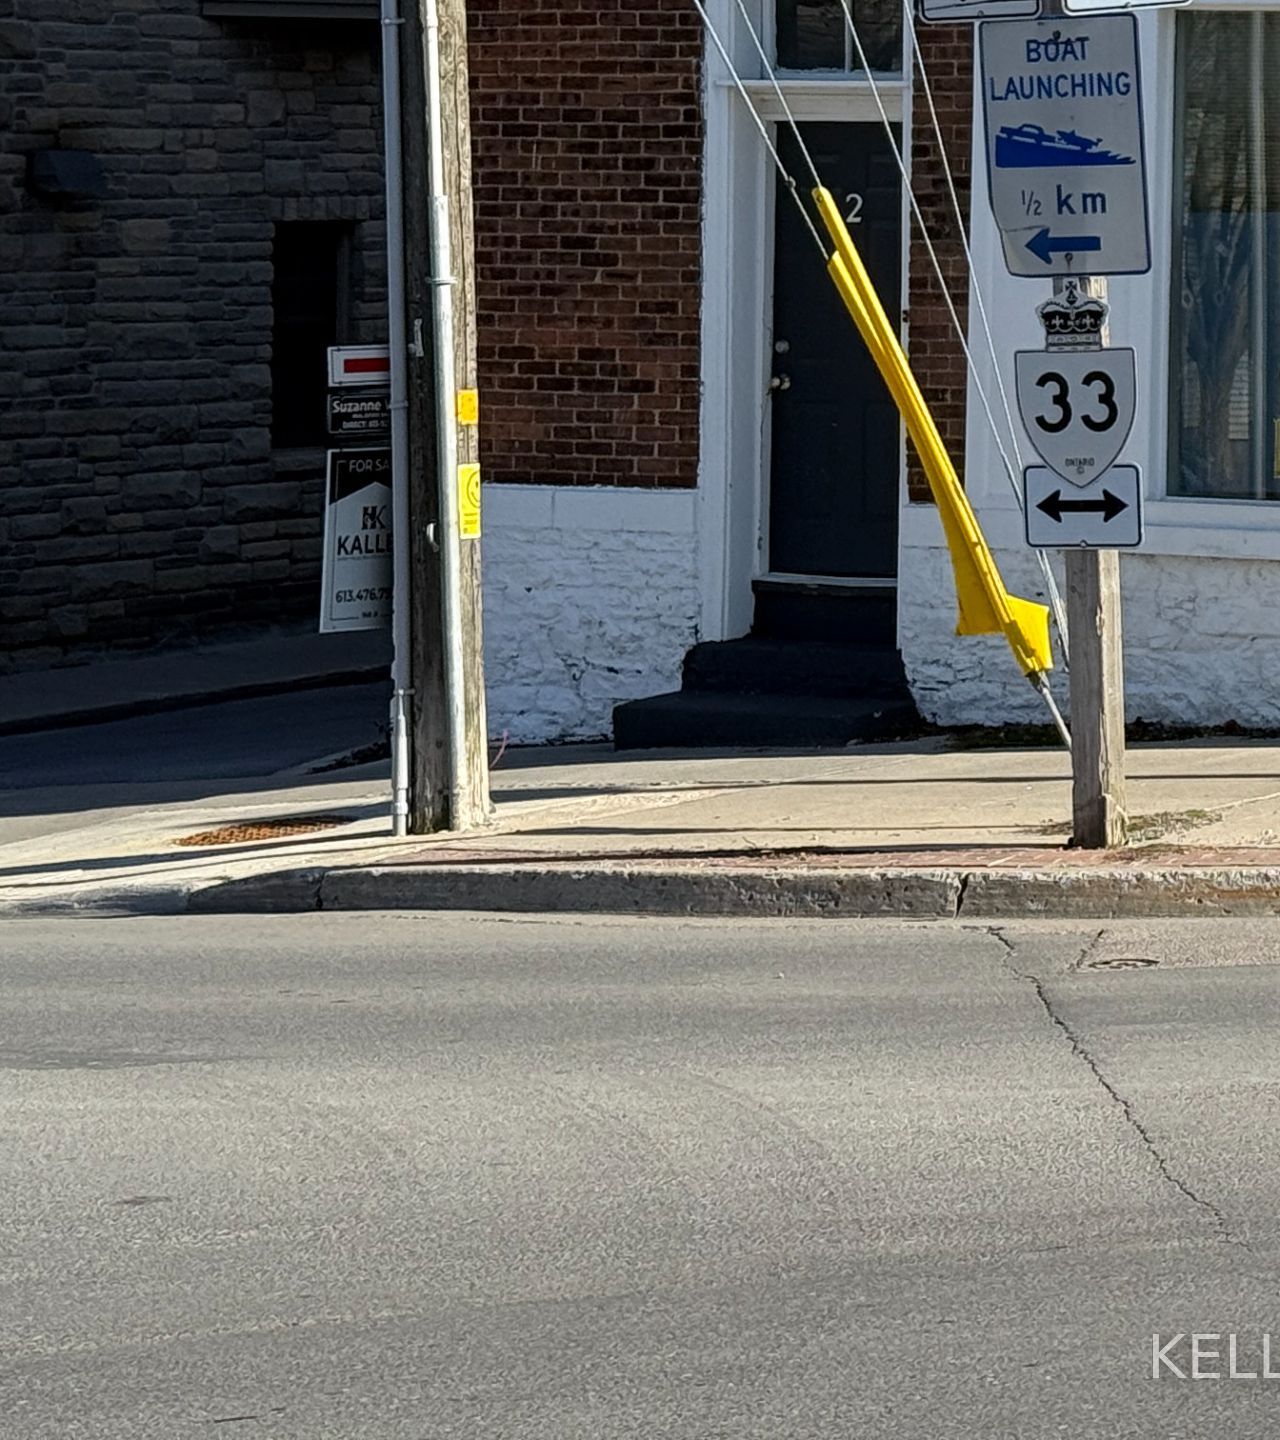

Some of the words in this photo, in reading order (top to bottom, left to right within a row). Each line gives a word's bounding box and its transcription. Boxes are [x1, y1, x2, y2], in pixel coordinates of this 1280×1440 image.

[1026, 37, 1090, 62] BOAT
[990, 71, 1132, 101] LAUNCHING
[846, 193, 863, 223] 2
[1056, 184, 1107, 215] km
[332, 400, 382, 413] Suzanne
[1035, 371, 1118, 433] 33
[348, 459, 373, 473] FOR
